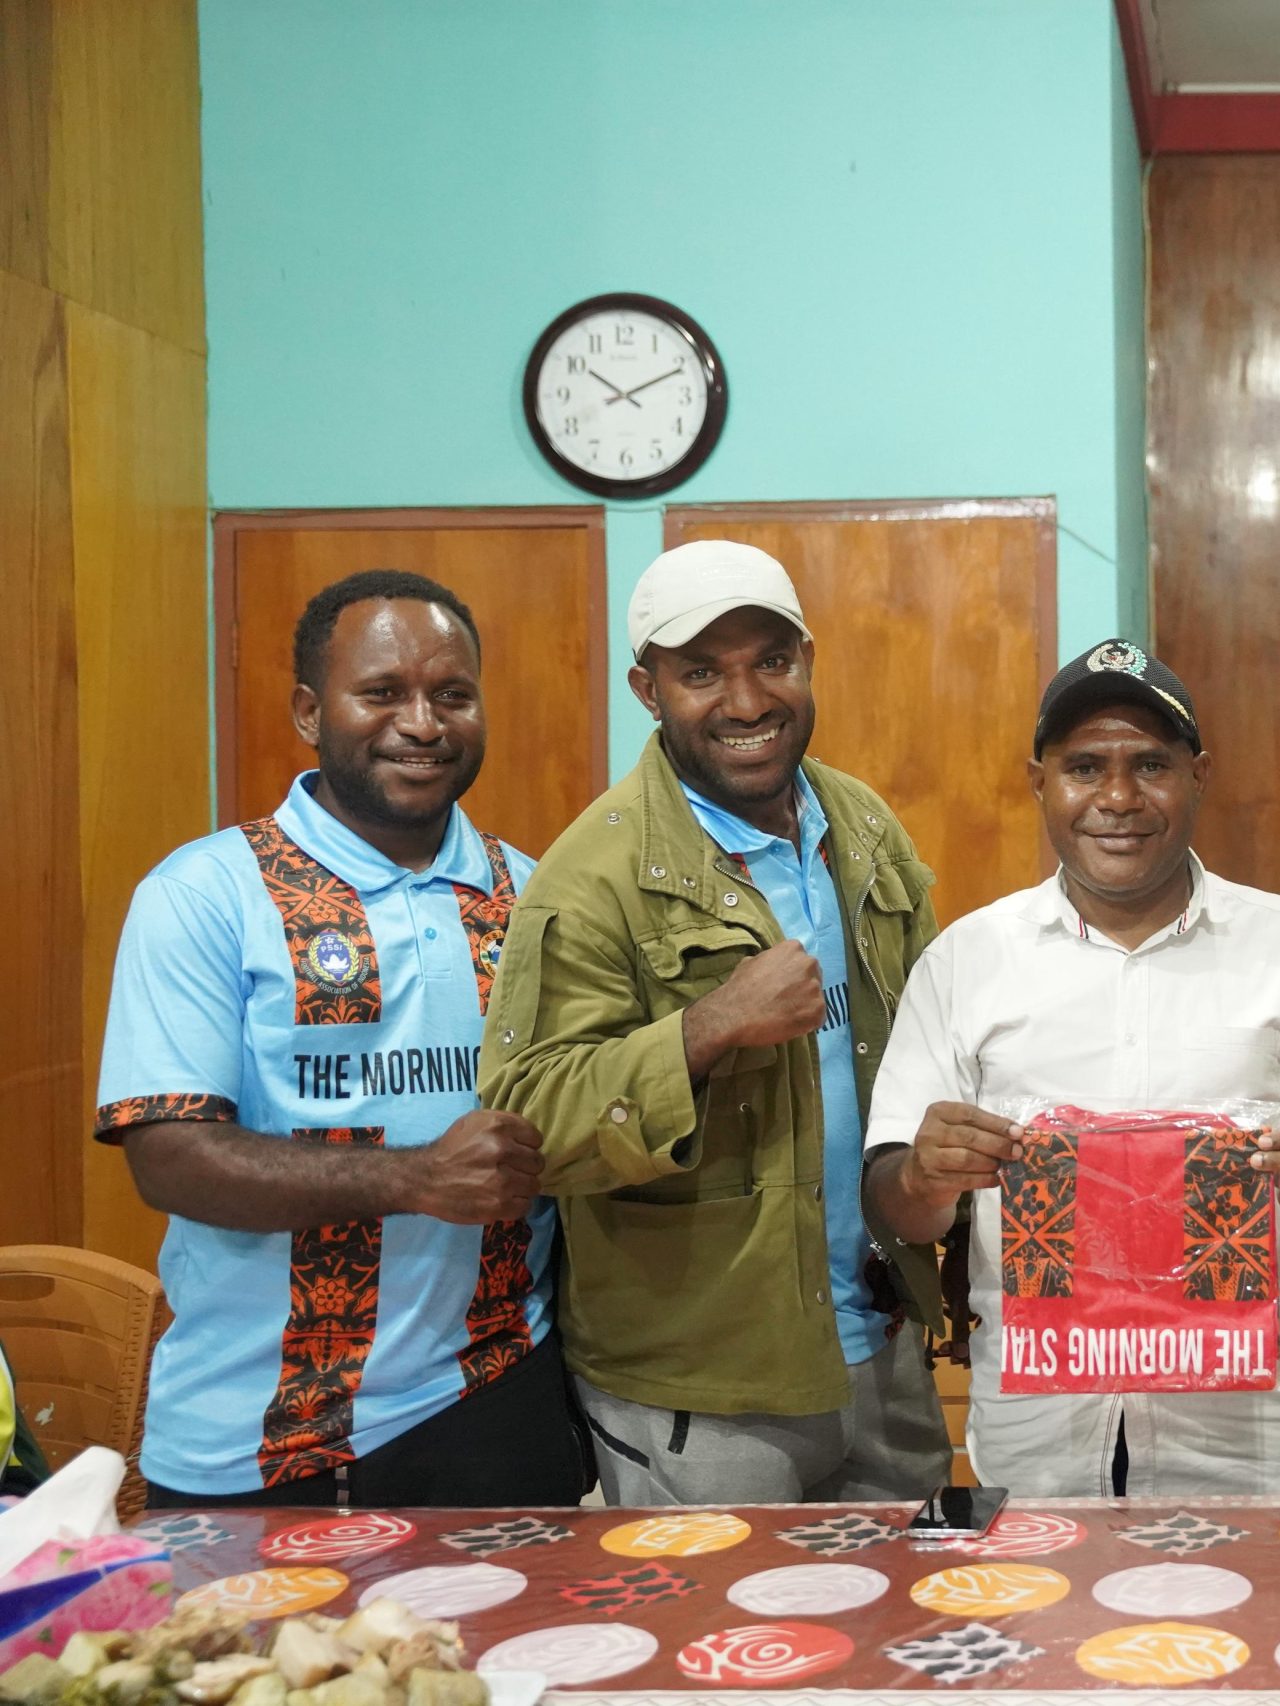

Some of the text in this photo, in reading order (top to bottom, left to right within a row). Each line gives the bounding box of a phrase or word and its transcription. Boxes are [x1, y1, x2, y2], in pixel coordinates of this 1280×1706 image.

[588, 334, 602, 354] 11
[614, 324, 635, 346] 12
[652, 334, 658, 354] 1
[567, 355, 586, 375] 10
[672, 356, 686, 375] 2
[557, 386, 570, 406] 9
[678, 386, 692, 406] 3
[564, 416, 579, 436] 8
[671, 416, 683, 436] 4
[588, 438, 600, 460] 7
[619, 449, 633, 467] 6
[650, 438, 662, 460] 5
[320, 943, 343, 953] PSSI
[294, 1054, 351, 1099] THE
[1068, 1327, 1203, 1376] MORNING
[1214, 1329, 1272, 1377] THE
